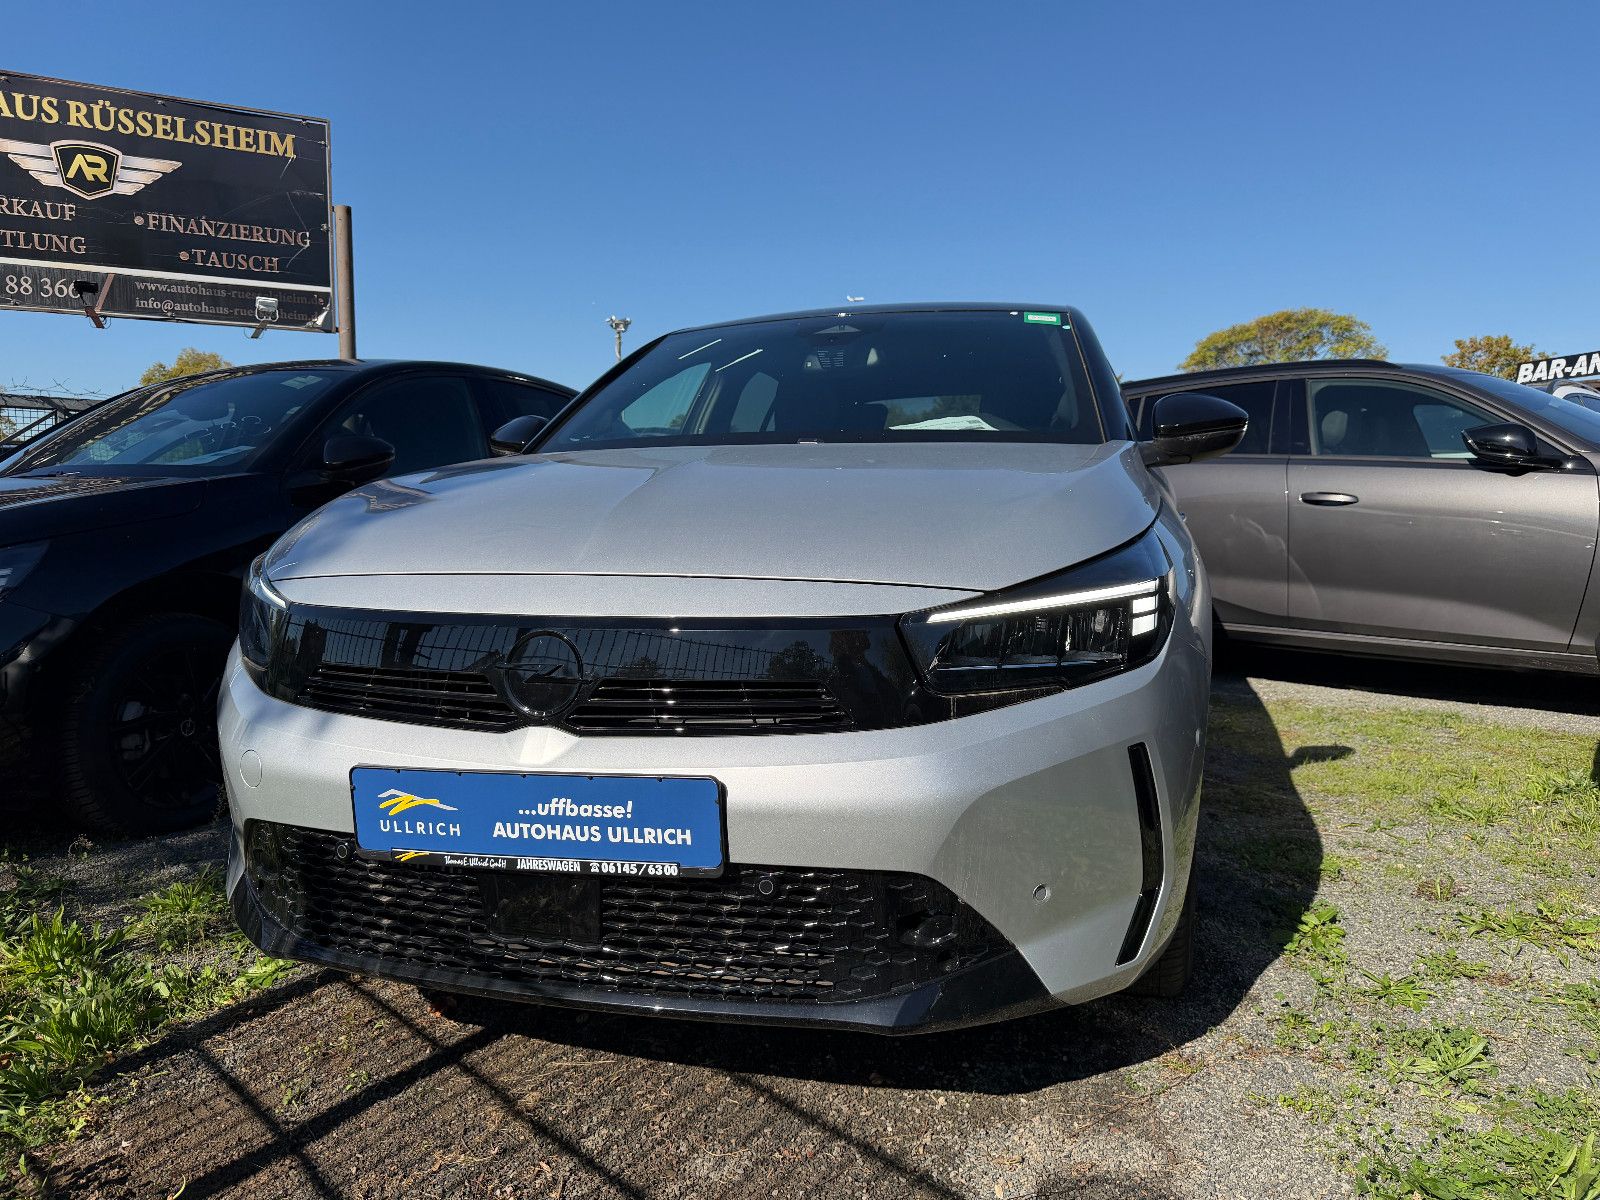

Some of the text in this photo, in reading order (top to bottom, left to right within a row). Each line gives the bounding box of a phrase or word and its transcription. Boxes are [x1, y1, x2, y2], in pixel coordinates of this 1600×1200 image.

[66, 99, 297, 158] RÜSSELSHEIM
[66, 153, 110, 183] AR
[147, 213, 311, 247] FINANZIERUNG
[192, 249, 280, 273] TAUSCH
[5, 274, 33, 295] 88
[518, 797, 633, 819] ...uffbasse!
[379, 819, 461, 837] ULLRICH
[492, 821, 693, 846] AUTOHAUS ULLRICH
[516, 858, 581, 872] JAHRESWAGEN
